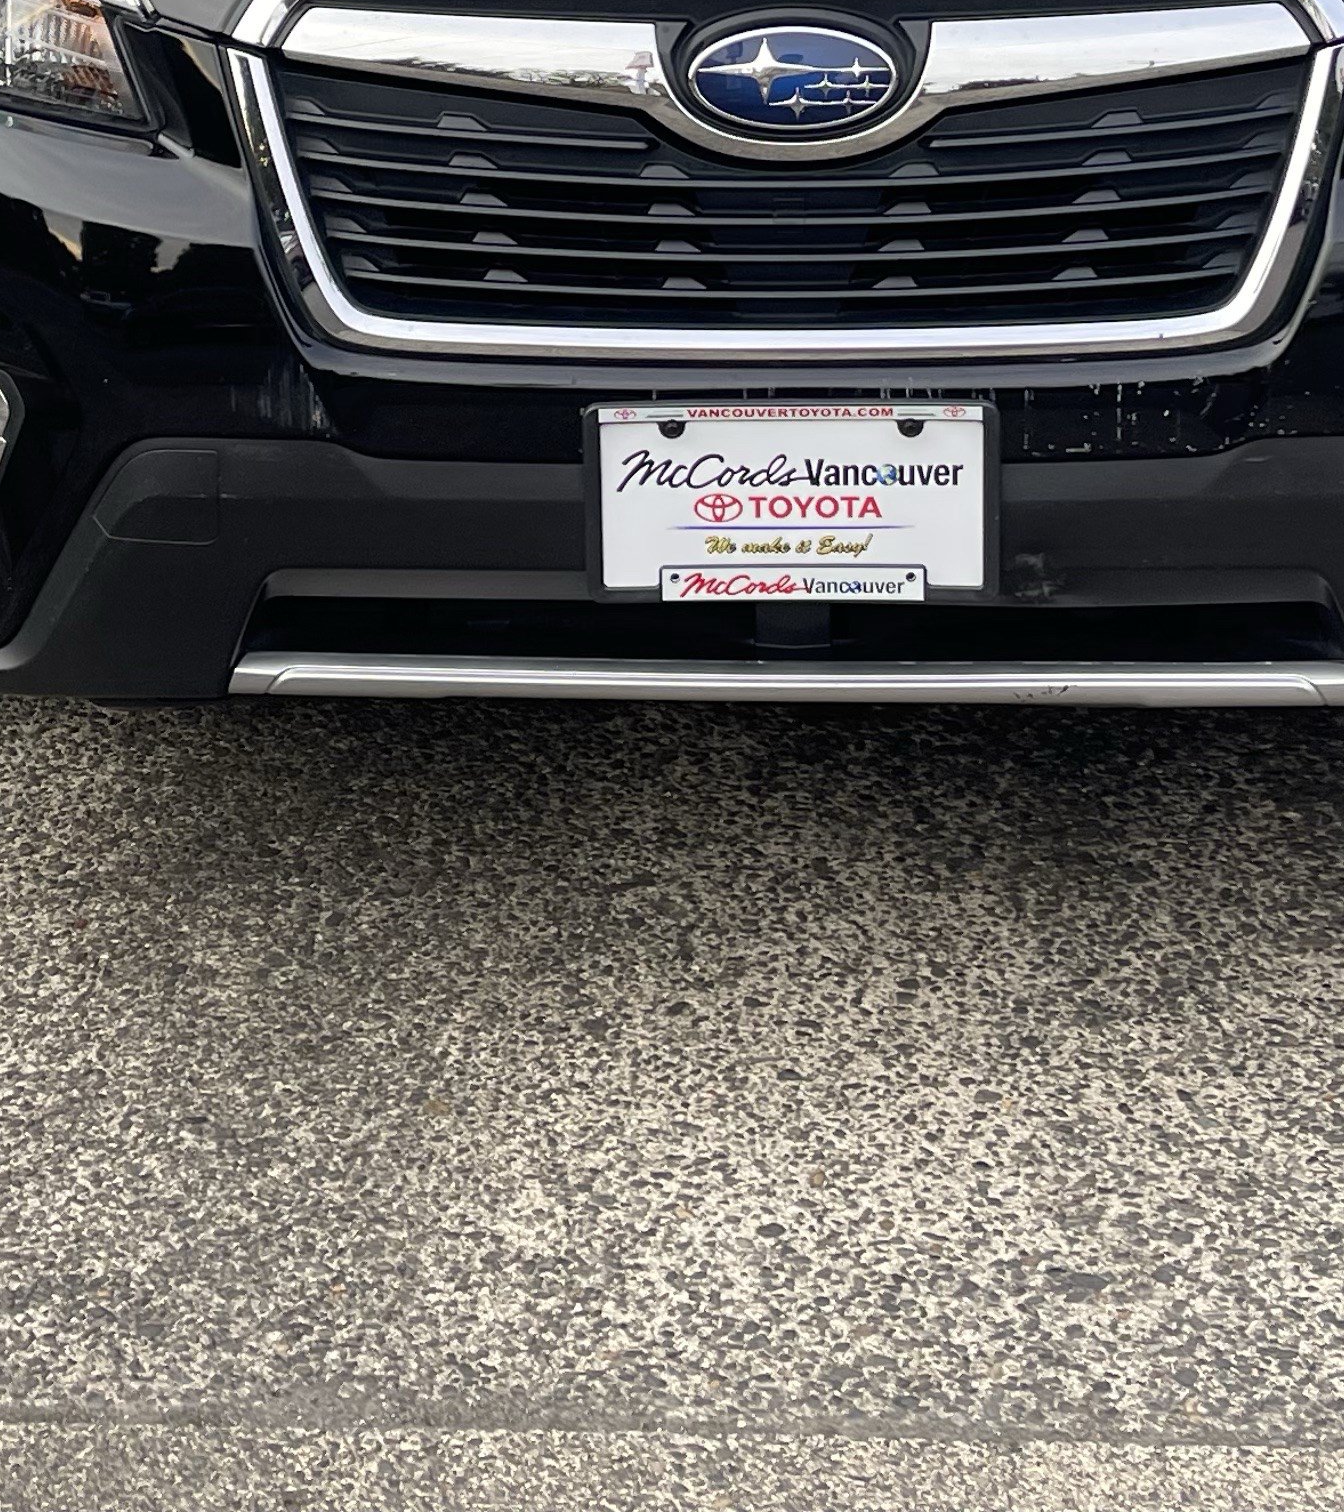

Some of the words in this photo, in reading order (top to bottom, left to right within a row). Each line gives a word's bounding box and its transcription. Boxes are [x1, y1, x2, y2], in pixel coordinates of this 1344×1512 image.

[686, 407, 894, 419] VANCOUVERTOYOTA.COM
[617, 449, 805, 493] McCords
[805, 457, 965, 487] Vancouver
[748, 495, 883, 519] TOYOTA
[704, 535, 738, 555] We
[741, 537, 792, 555] make
[794, 538, 812, 555] it
[815, 532, 874, 558] Easy!
[680, 572, 804, 598] McCords
[803, 577, 906, 595] Vancouver
